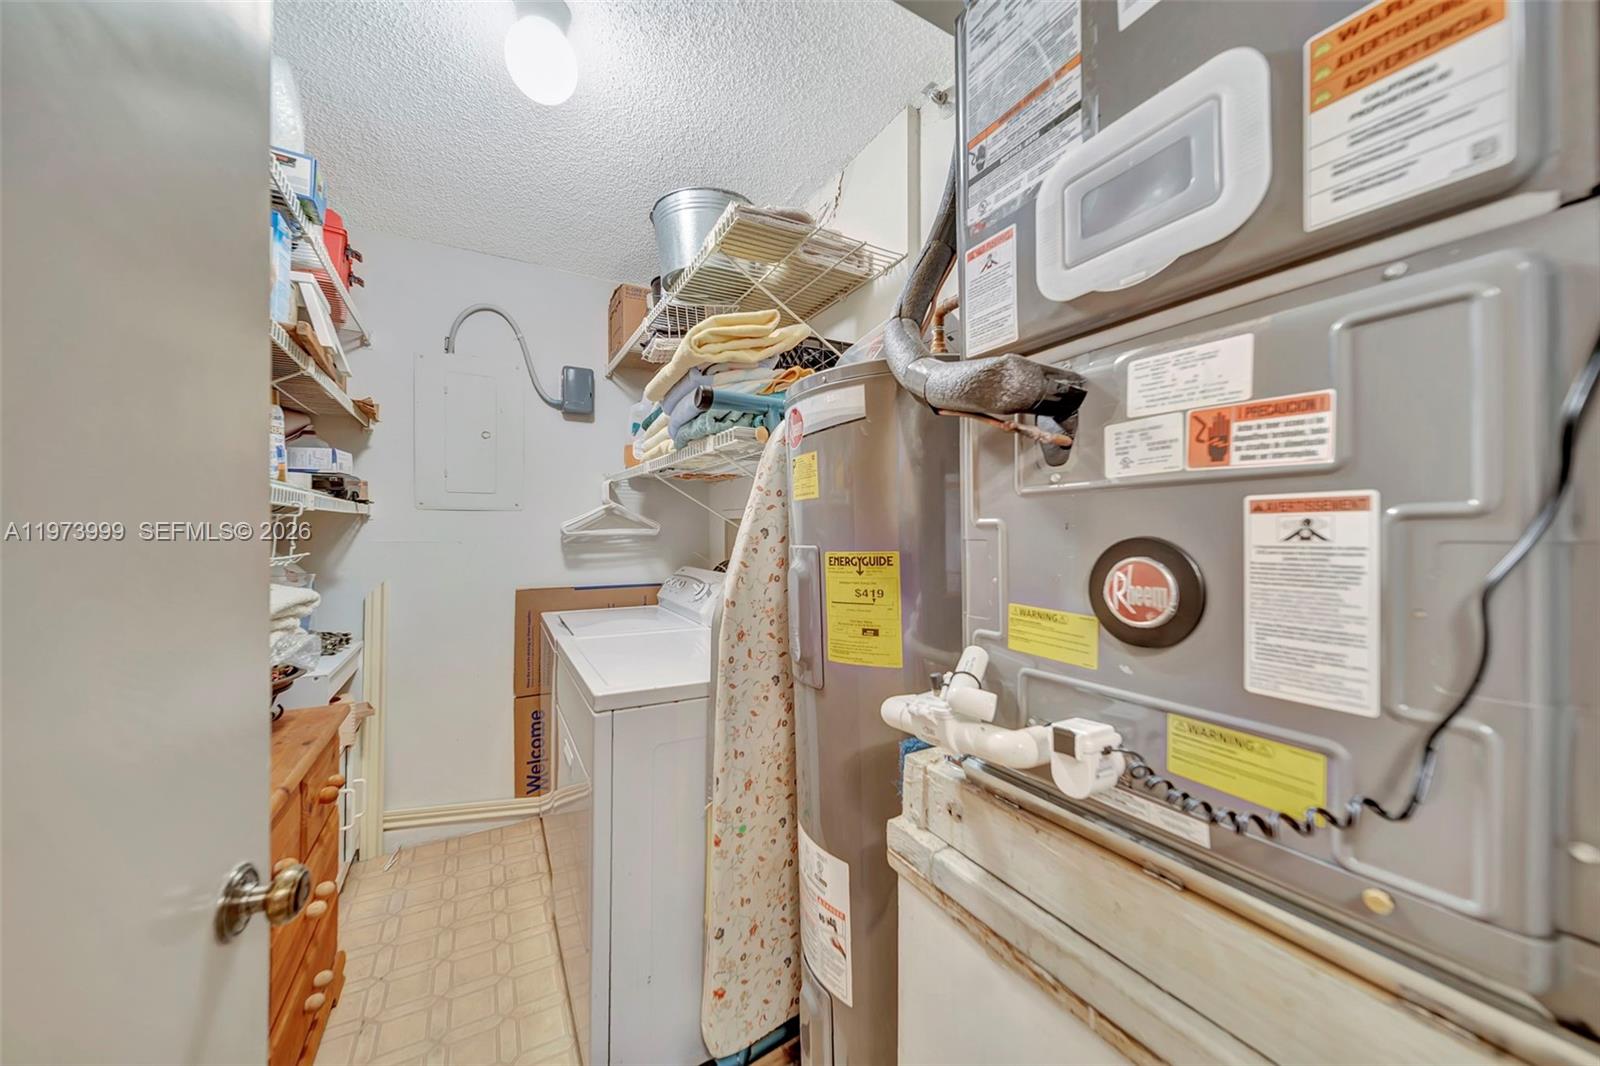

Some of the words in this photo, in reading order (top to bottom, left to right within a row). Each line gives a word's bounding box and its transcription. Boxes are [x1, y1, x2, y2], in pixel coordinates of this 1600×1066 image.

[854, 588, 885, 598] $419
[1113, 565, 1168, 614] Rheem
[1018, 608, 1058, 624] WARNING
[1185, 722, 1255, 750] WARNING
[526, 710, 541, 795] Welcome
